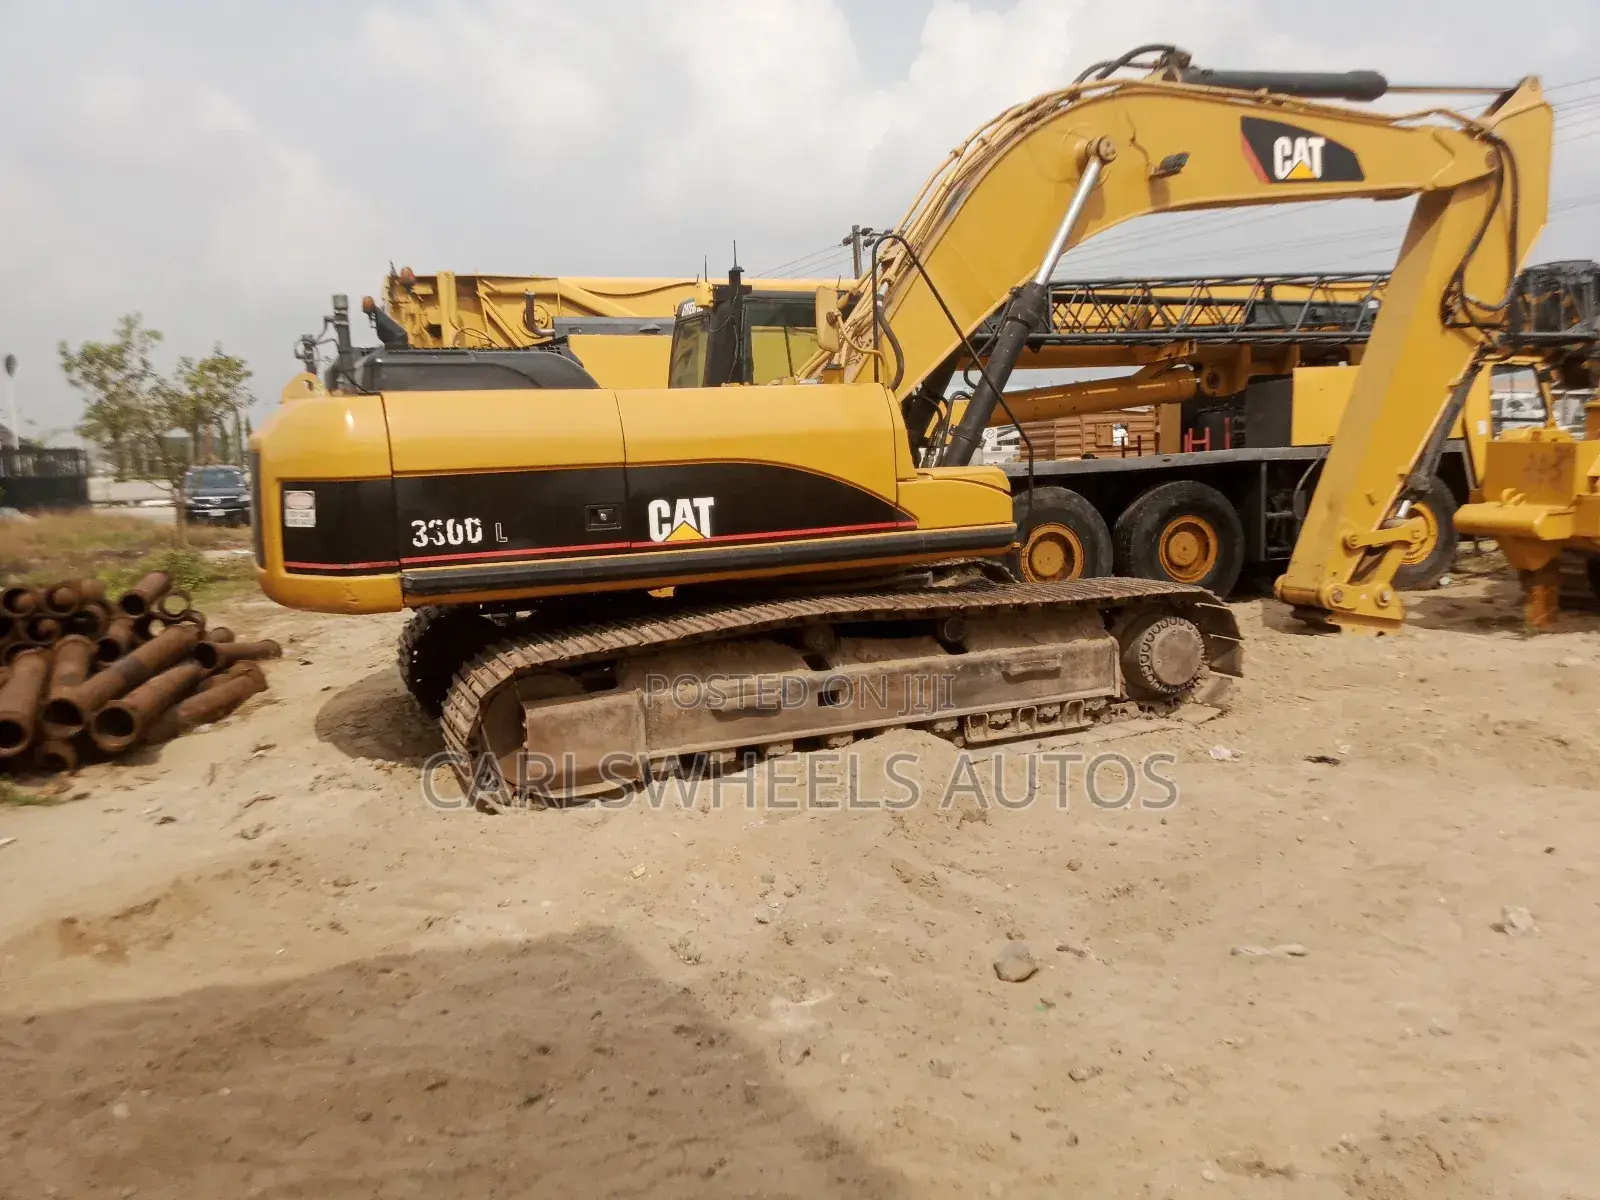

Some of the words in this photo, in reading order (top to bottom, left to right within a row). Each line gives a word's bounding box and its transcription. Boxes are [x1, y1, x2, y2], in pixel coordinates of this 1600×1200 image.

[1273, 136, 1326, 180] CAT
[495, 522, 508, 542] L
[648, 497, 715, 542] CAT
